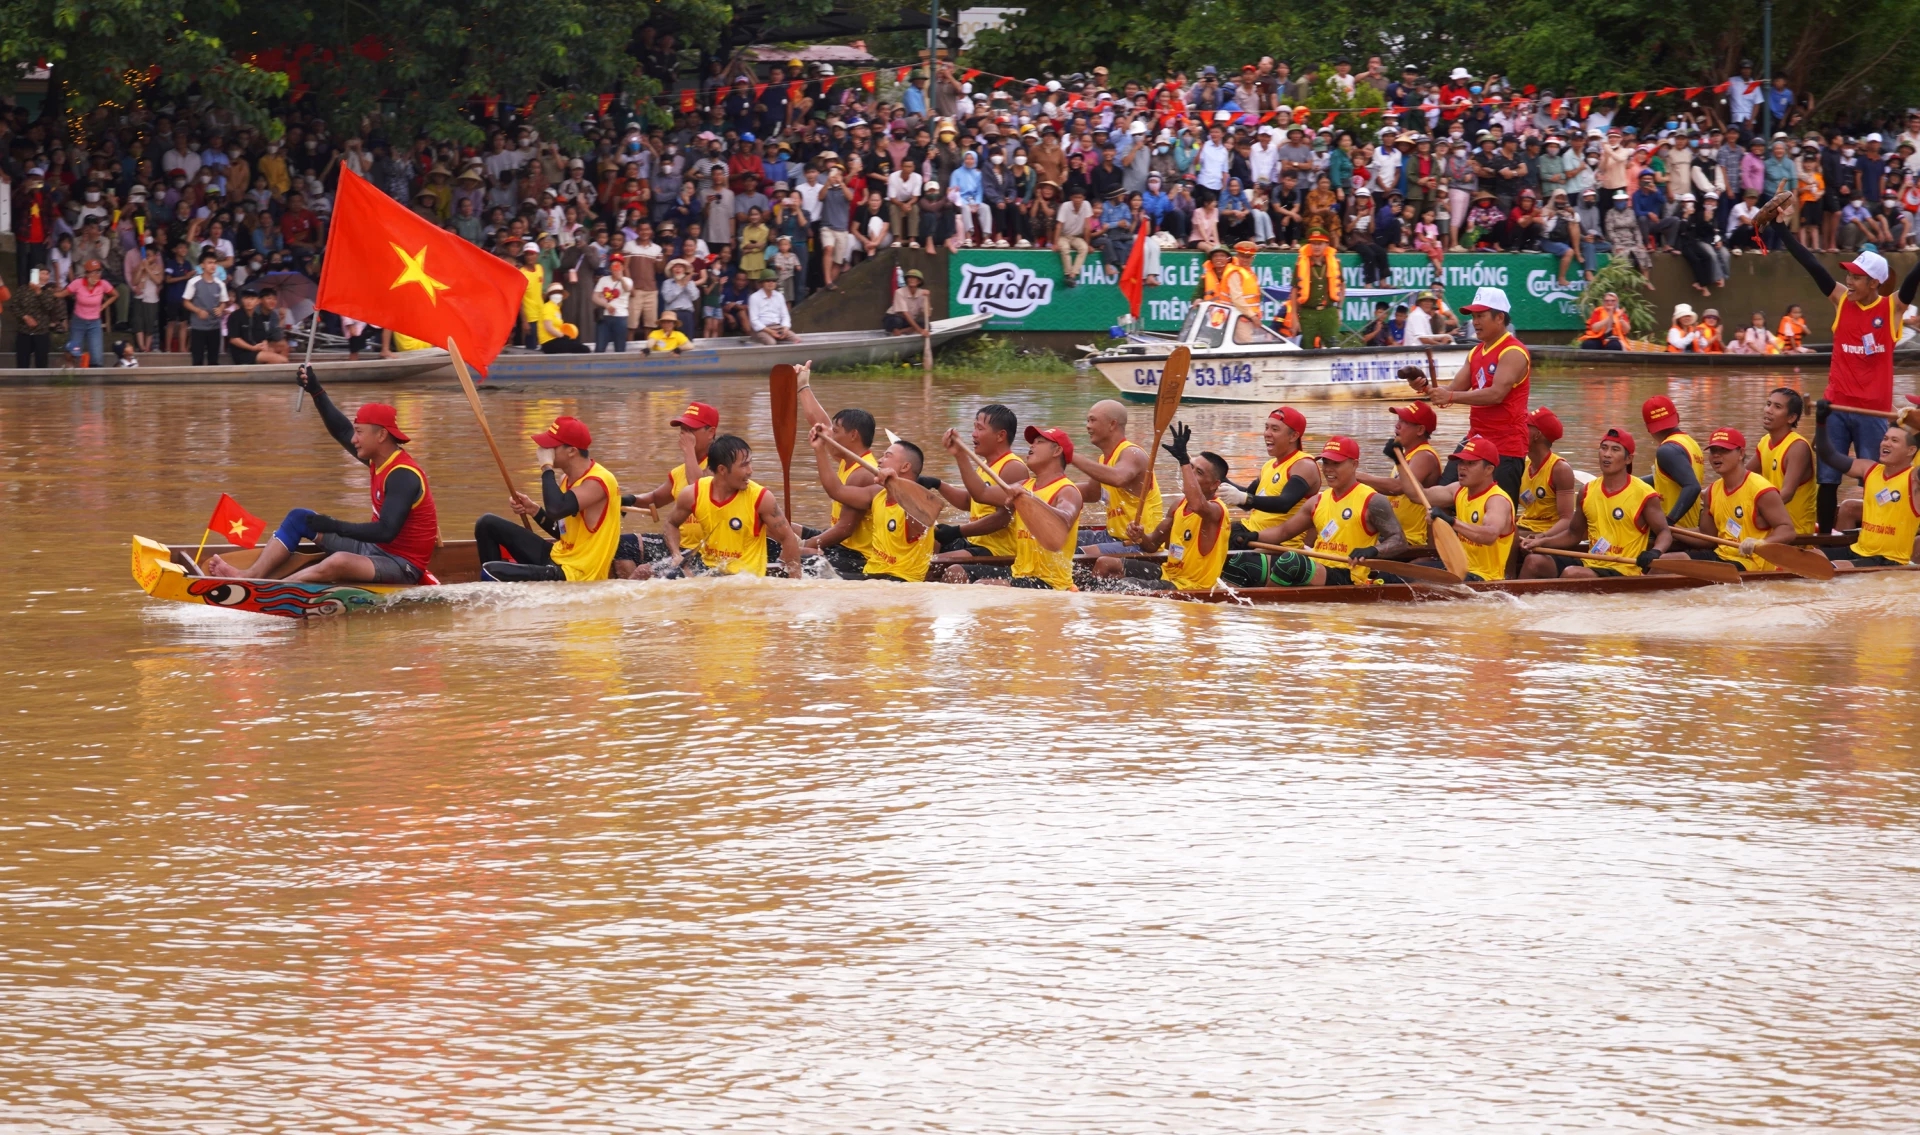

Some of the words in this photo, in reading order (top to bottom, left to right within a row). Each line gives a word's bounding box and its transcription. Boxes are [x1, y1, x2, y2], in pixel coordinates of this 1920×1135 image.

[1449, 260, 1508, 287] THỐNG
[962, 267, 1048, 312] huda
[1195, 363, 1253, 386] 53.043
